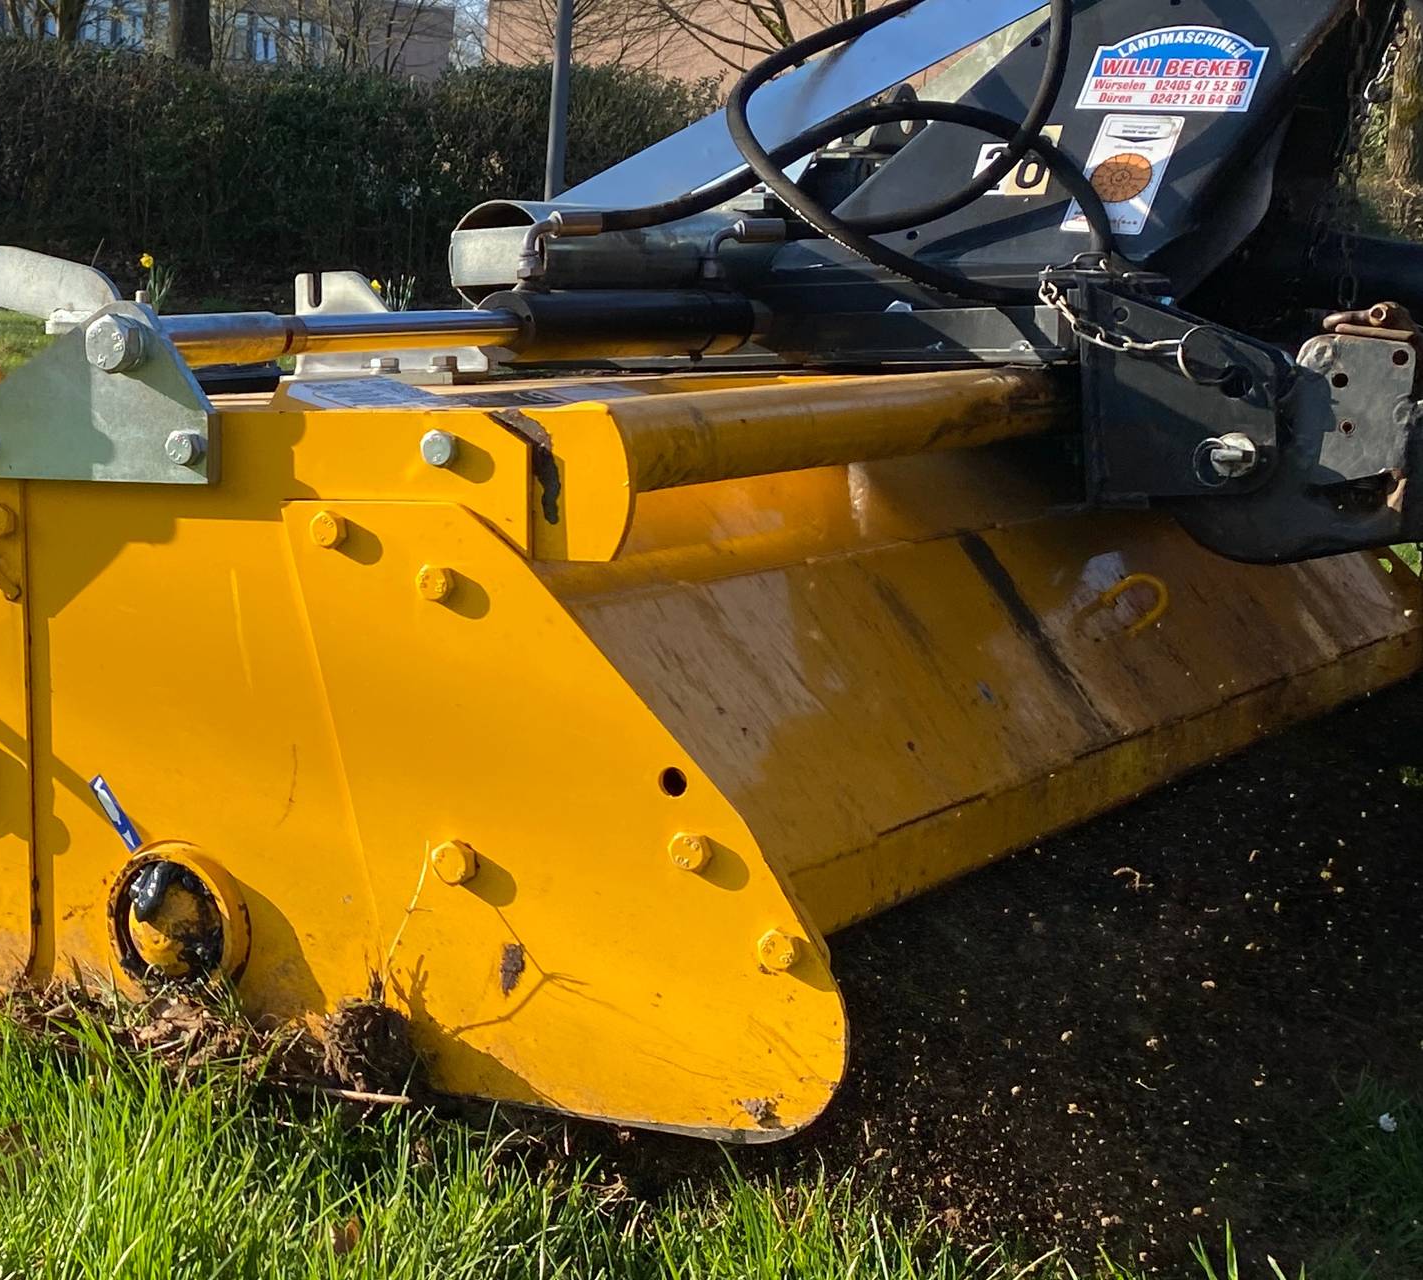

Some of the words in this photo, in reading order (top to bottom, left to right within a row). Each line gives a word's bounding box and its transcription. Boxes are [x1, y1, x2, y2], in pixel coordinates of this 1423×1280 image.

[1117, 31, 1248, 58] LANDMASCHINEN
[1101, 58, 1160, 76] WILLI
[1164, 59, 1253, 77] BECKER
[1093, 79, 1146, 91] Würselen
[1194, 80, 1210, 91] 47
[1212, 81, 1228, 91] 52
[1231, 81, 1247, 92] 90
[1098, 92, 1133, 103] Düren
[1149, 93, 1187, 105] 02421
